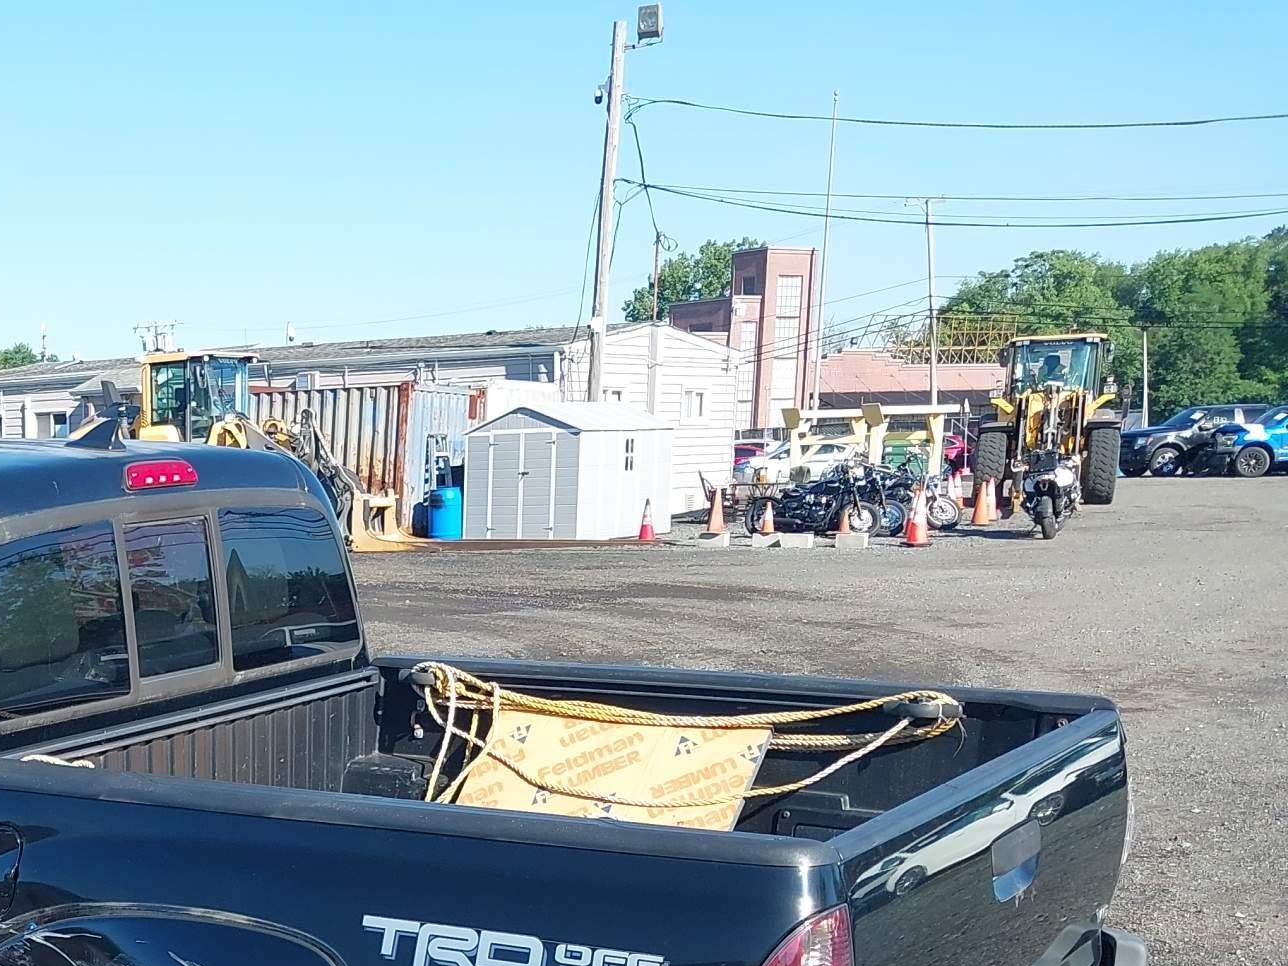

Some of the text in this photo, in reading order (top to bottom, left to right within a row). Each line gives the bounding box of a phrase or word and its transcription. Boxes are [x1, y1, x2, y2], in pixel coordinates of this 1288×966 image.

[537, 731, 644, 781] Feldman
[558, 750, 642, 788] UMBER
[649, 757, 738, 799] LUMBER
